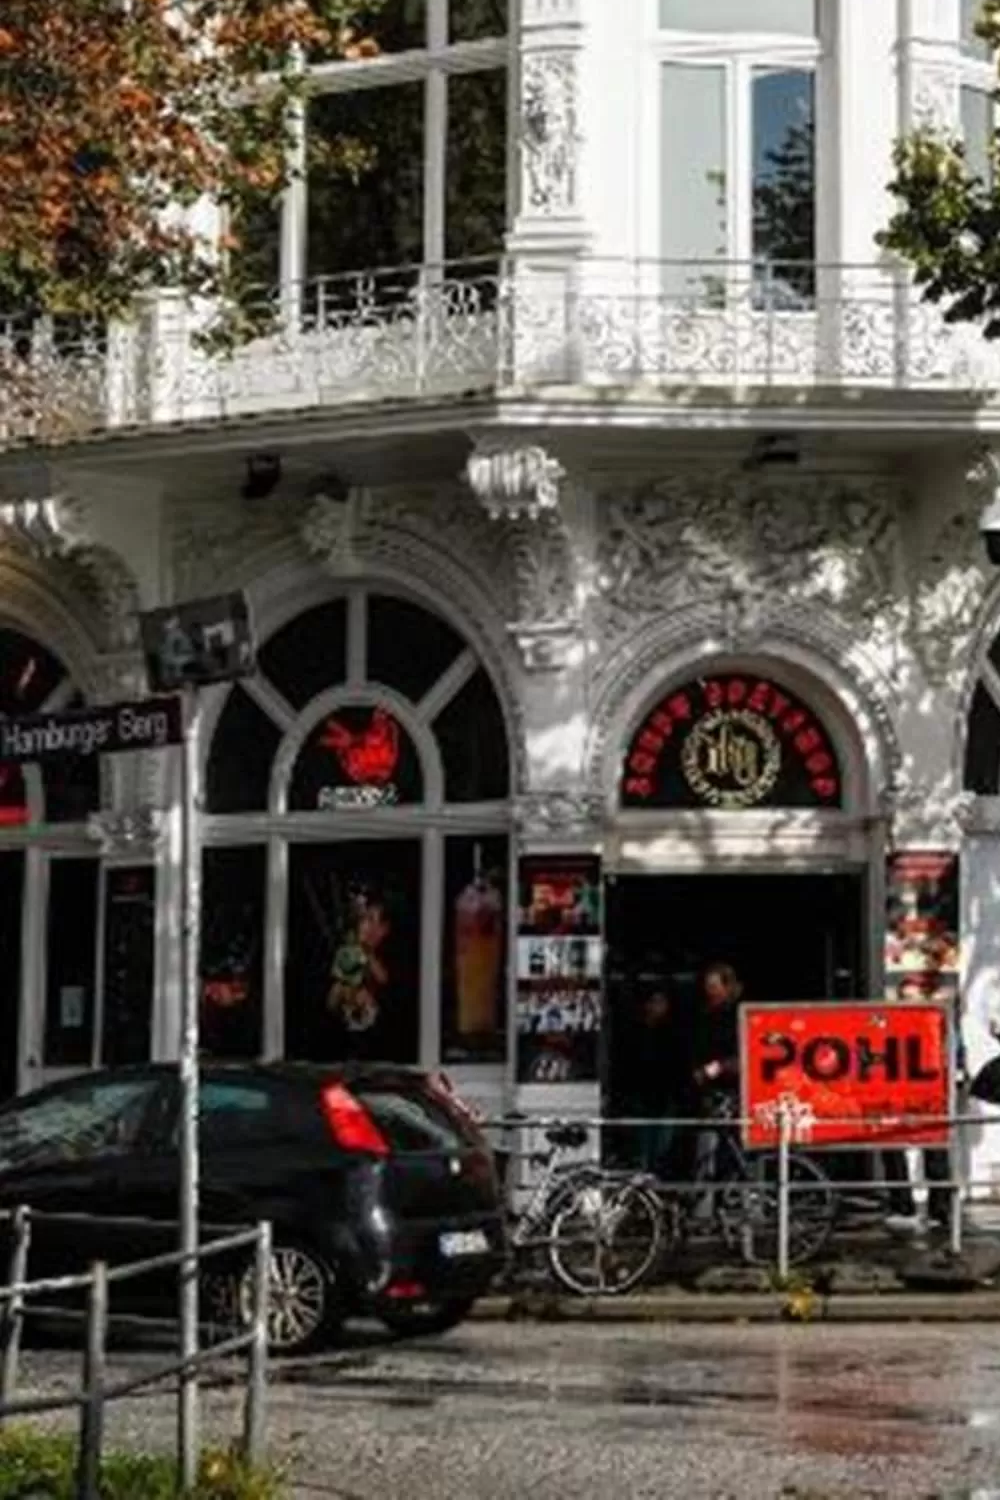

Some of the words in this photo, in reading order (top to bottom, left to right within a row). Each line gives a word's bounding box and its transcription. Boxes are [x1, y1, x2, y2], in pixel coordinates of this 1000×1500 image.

[3, 719, 113, 754] Hamburger
[118, 708, 168, 745] Berg
[760, 1031, 939, 1083] POHL
